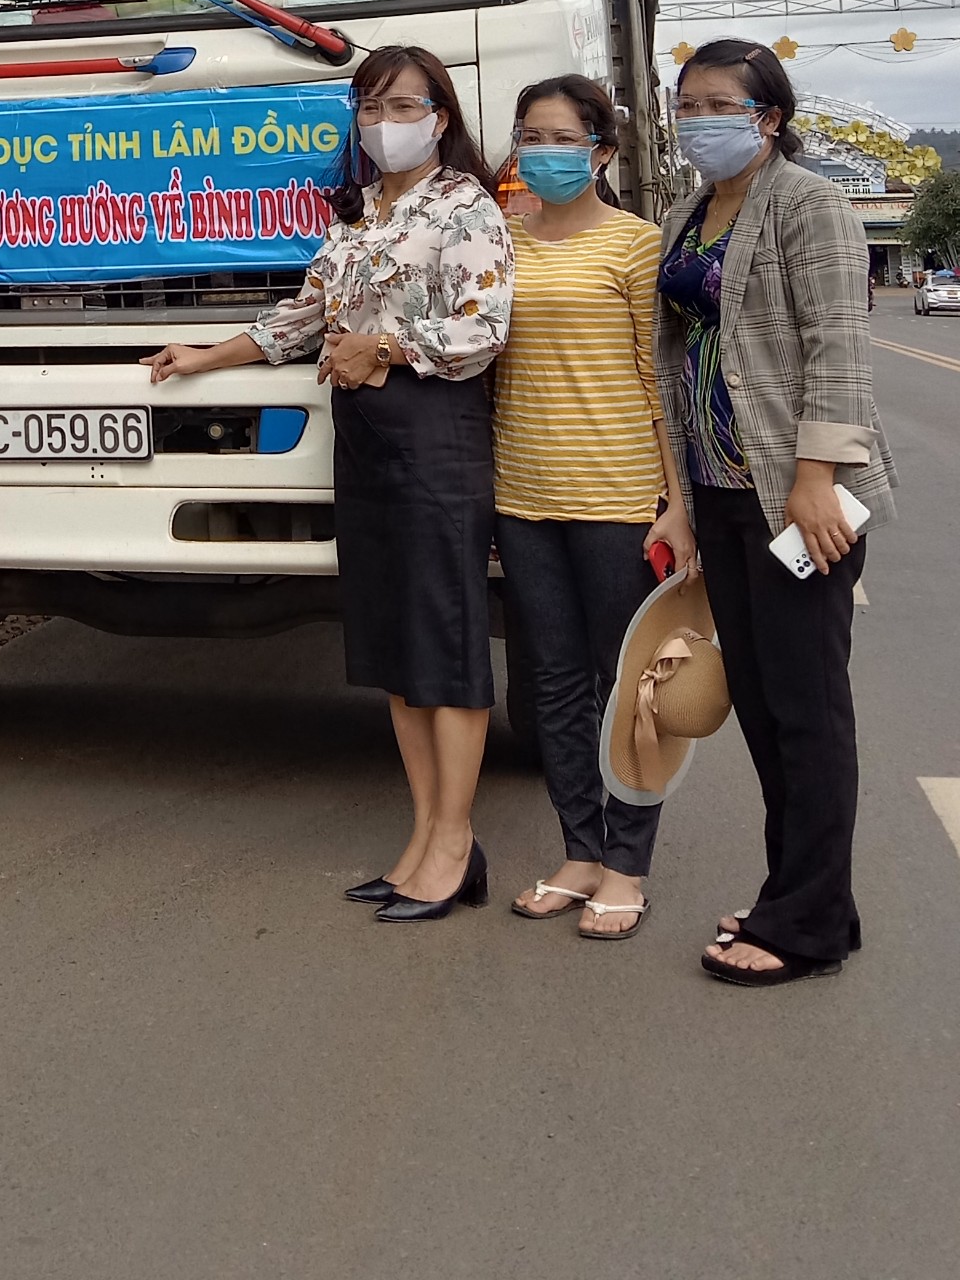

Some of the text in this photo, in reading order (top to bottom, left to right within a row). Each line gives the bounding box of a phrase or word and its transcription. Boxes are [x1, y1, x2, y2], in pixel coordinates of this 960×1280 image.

[67, 122, 141, 162] TỈNH
[152, 120, 221, 158] LÂM
[231, 109, 340, 155] ĐỒNG
[58, 179, 147, 248] HƯỚNG
[149, 167, 187, 243] VỀ
[188, 176, 255, 242] BÌNH
[256, 177, 342, 240] DƯƠN
